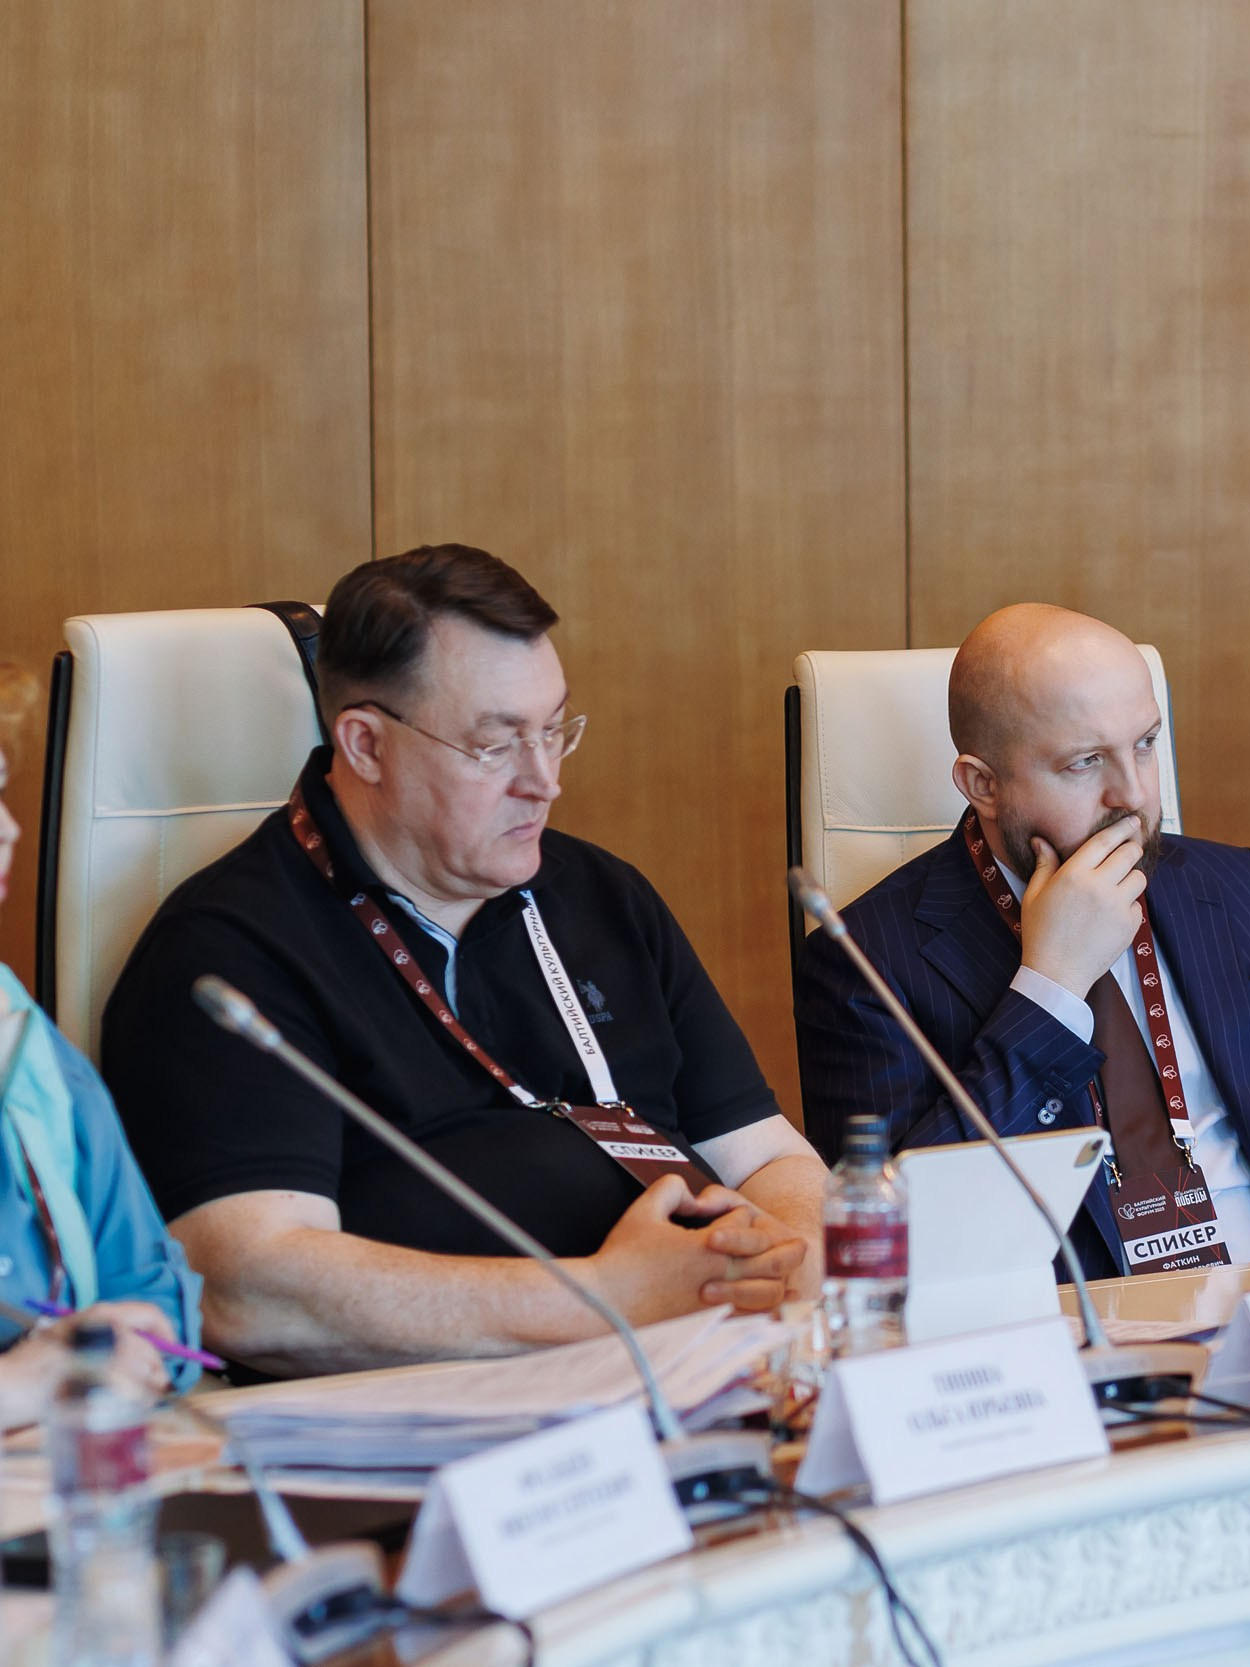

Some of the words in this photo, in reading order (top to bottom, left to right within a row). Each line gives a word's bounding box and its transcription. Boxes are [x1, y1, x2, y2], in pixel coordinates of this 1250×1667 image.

[552, 976, 596, 1056] БАЛТИЙСКИЙ
[611, 1145, 678, 1158] СПИКЕР
[1133, 1195, 1166, 1207] БАЛТИЙСКИЙ
[1175, 1190, 1207, 1208] ПОБЕДЫ
[1135, 1201, 1167, 1212] КУЛЬТУРНЫЙ
[1137, 1209, 1155, 1217] ФОРУМ
[1133, 1225, 1217, 1258] СПИКЕР
[1162, 1255, 1200, 1270] ФАТКИН
